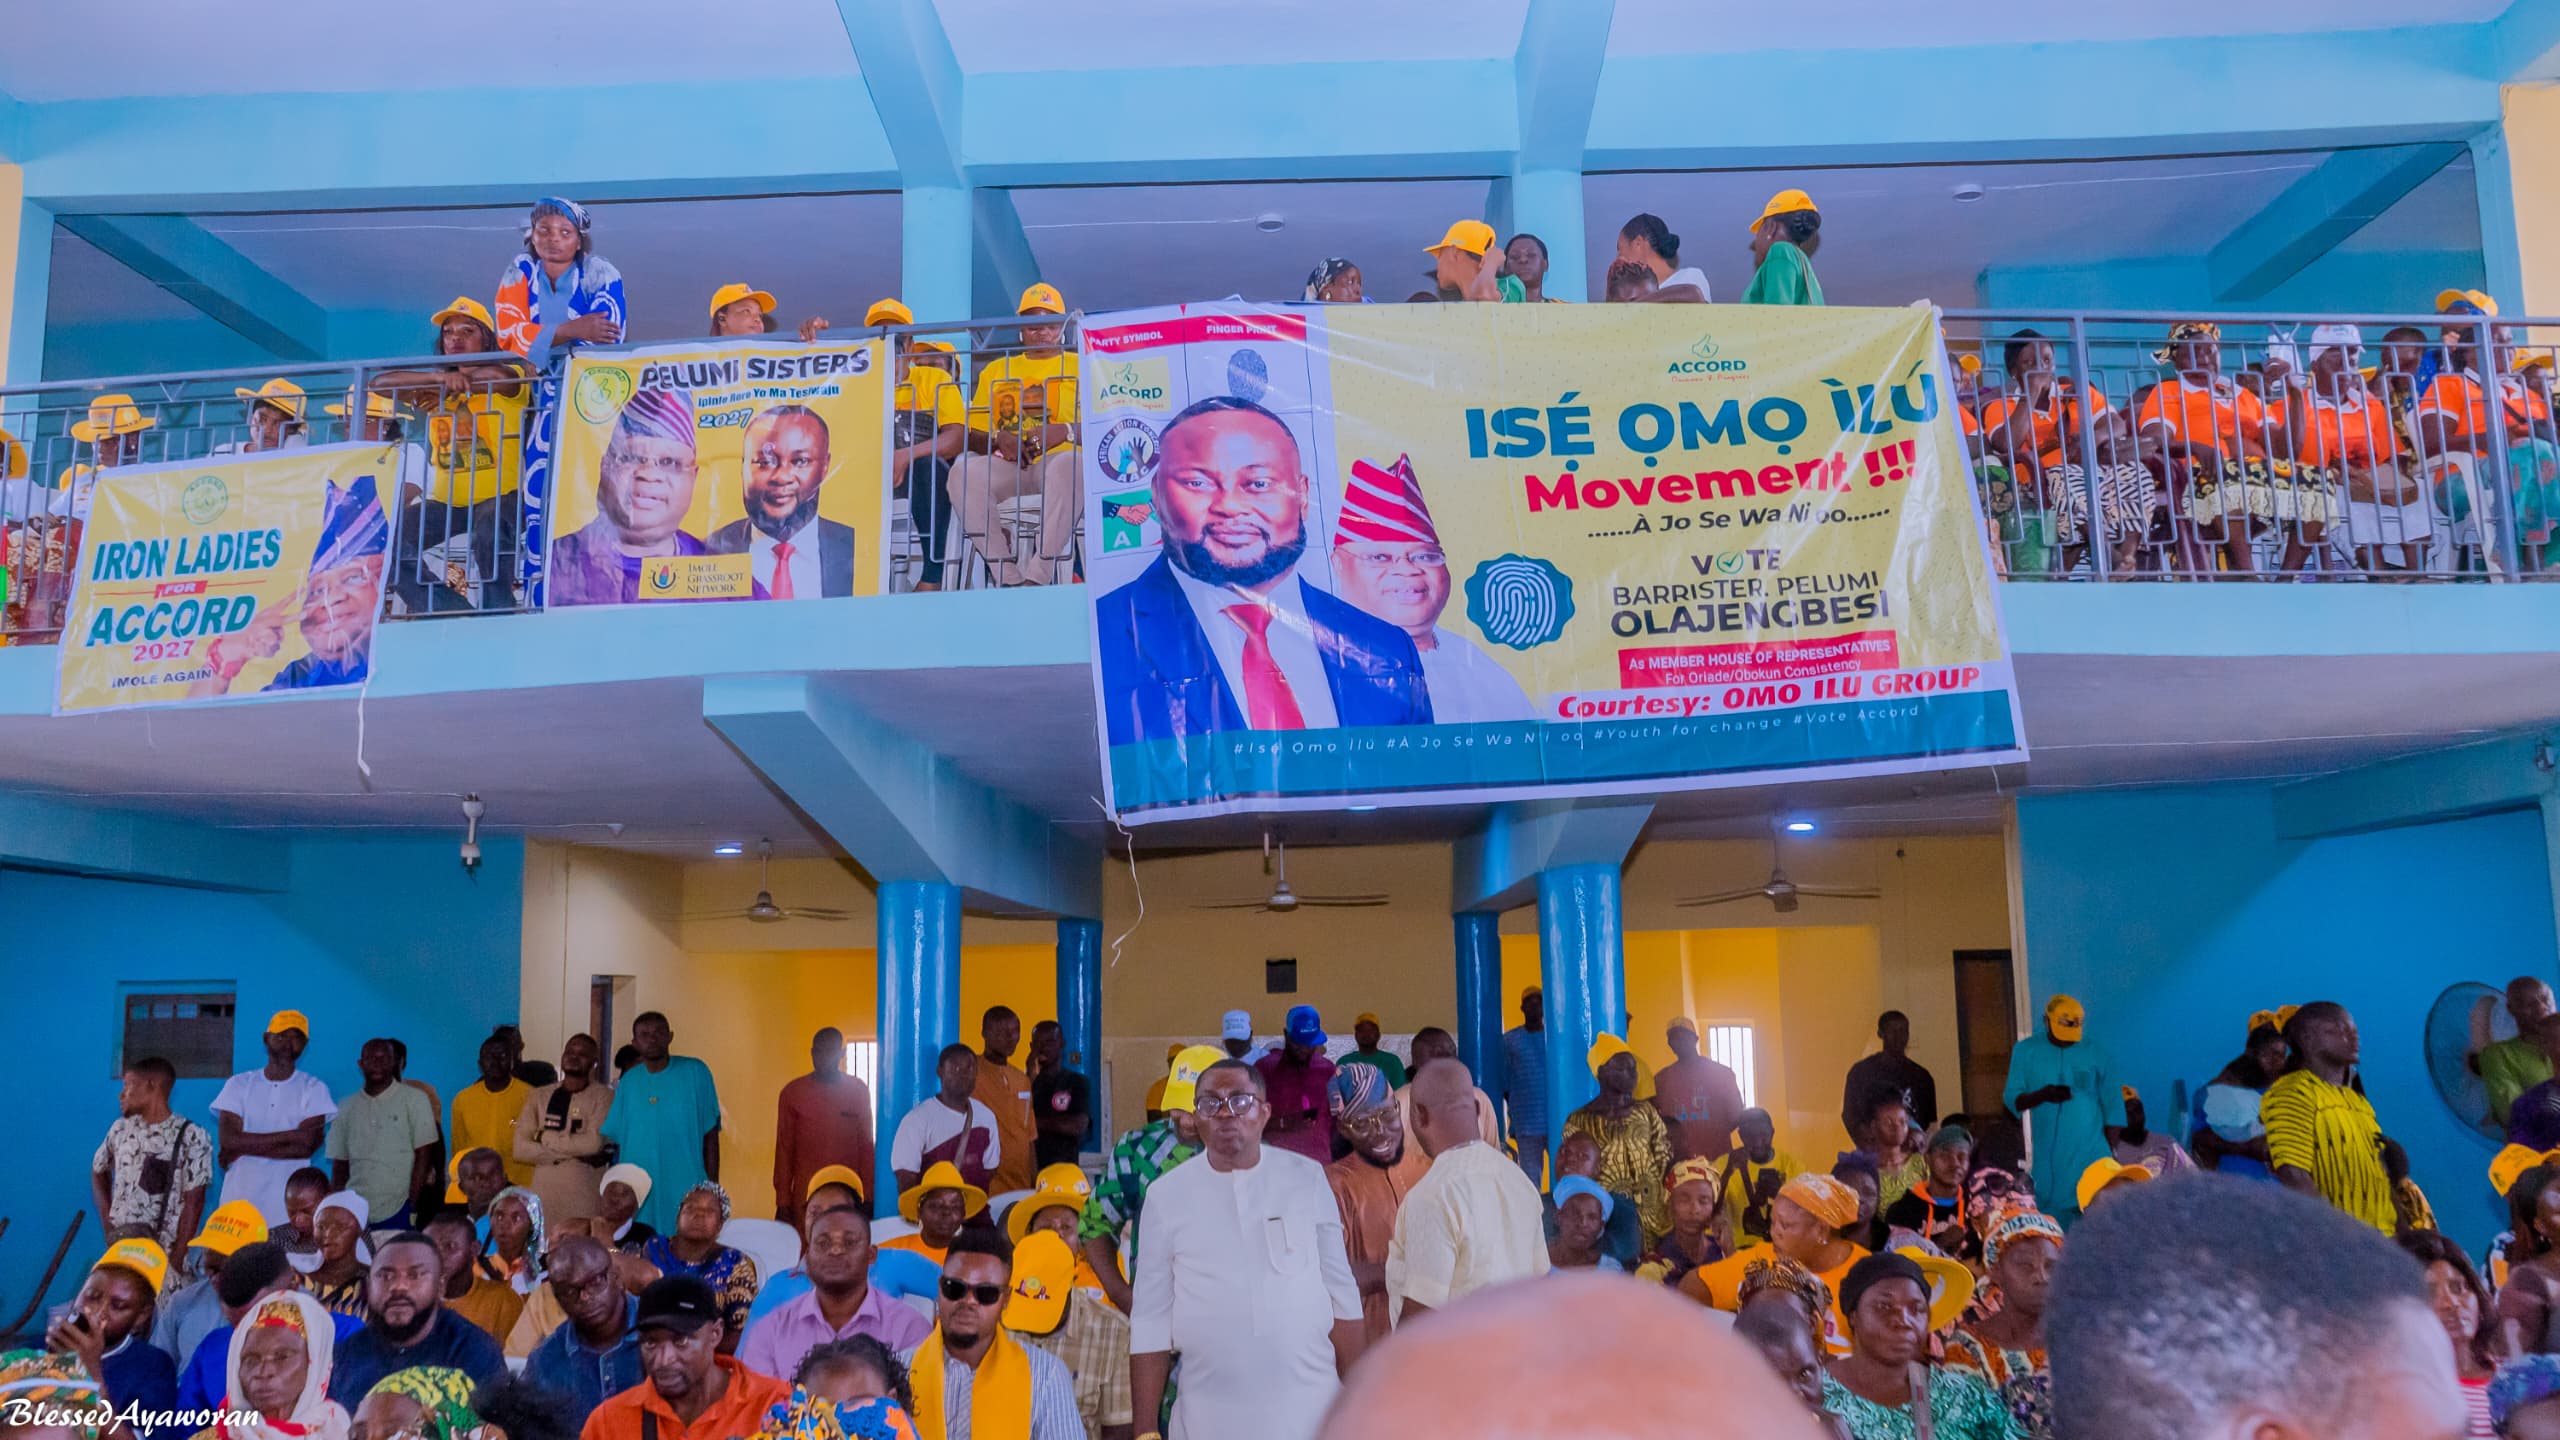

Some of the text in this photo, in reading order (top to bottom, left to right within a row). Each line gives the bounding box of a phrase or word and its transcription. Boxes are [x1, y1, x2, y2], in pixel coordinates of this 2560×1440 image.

[1089, 331, 1163, 347] PARTY SYMBOL
[1206, 325, 1244, 334] FINGER
[640, 348, 870, 388] PELUMI SISTERS
[1668, 360, 1746, 374] ACCORD
[753, 388, 766, 398] Yo
[769, 388, 786, 398] Ma
[1100, 384, 1163, 400] ACCORD
[698, 408, 753, 428] 2027
[1524, 451, 1852, 513] Movement
[1659, 516, 1691, 532] Jo
[1699, 511, 1731, 529] Se
[1739, 508, 1781, 527] Wa
[1789, 501, 1811, 522] Ni
[1113, 530, 1132, 550] A
[92, 528, 281, 581] IRON LADIES
[164, 582, 196, 595] FOR
[687, 583, 736, 593] NETWORK
[1778, 571, 1879, 596] PELUMI
[86, 595, 256, 647] ACCORD
[1611, 590, 1889, 638] OLAJENGBESI
[133, 640, 195, 662] 2027
[1629, 639, 1890, 670] As MEMBER HOUSE OF REPRESENTATIVES
[163, 669, 211, 683] AGAIN
[1665, 659, 1861, 685] For Oriade/Obokun Consistency
[1558, 666, 1980, 719] Courtesy: OMO ILU GROUP
[1453, 736, 1473, 747] Se
[1486, 734, 1512, 745] Wa
[1594, 726, 1661, 740] #Youth
[1672, 723, 1698, 736] for
[1710, 715, 1782, 734] change
[1793, 711, 1846, 726] #Vote
[1857, 705, 1919, 721] Accord
